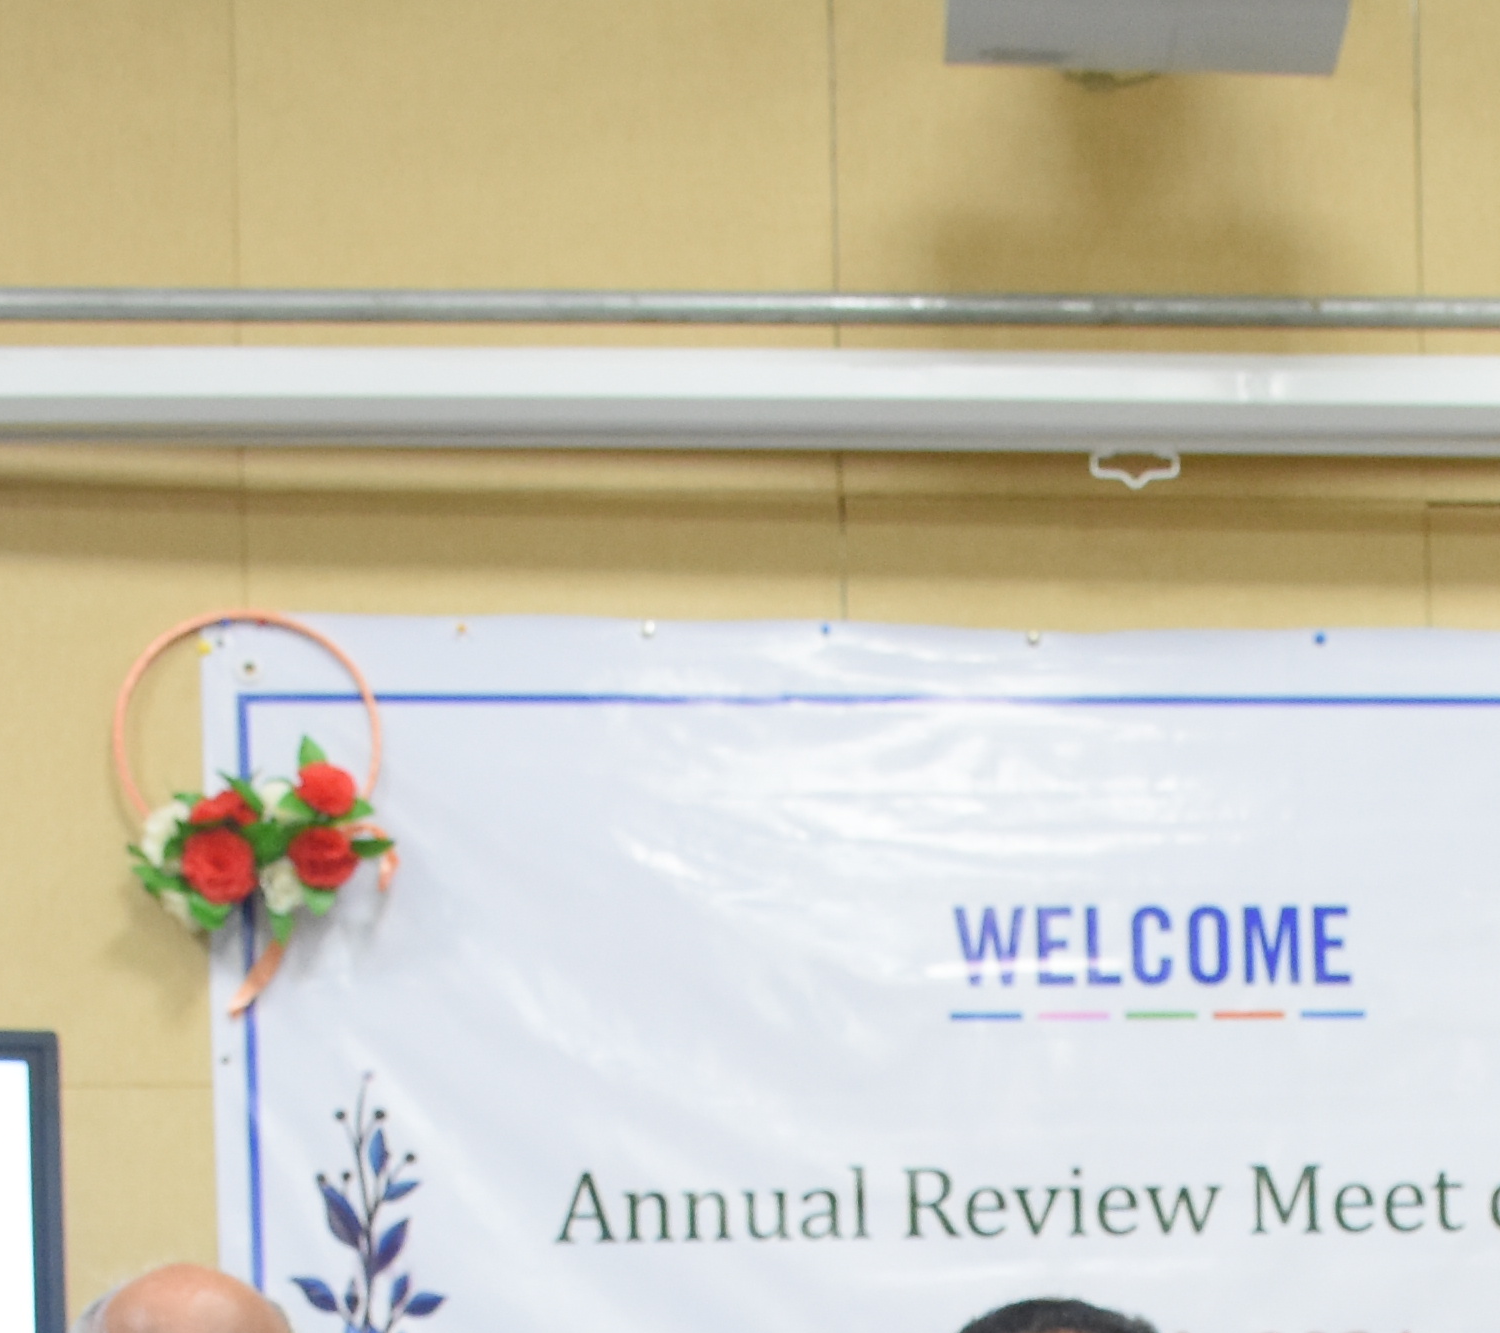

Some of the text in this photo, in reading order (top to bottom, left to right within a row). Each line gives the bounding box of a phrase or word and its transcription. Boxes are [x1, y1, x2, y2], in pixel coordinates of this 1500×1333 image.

[953, 905, 1353, 986] WELCOME
[555, 1165, 872, 1244] Annual
[902, 1166, 1222, 1238] Review
[1250, 1164, 1464, 1235] Meet
